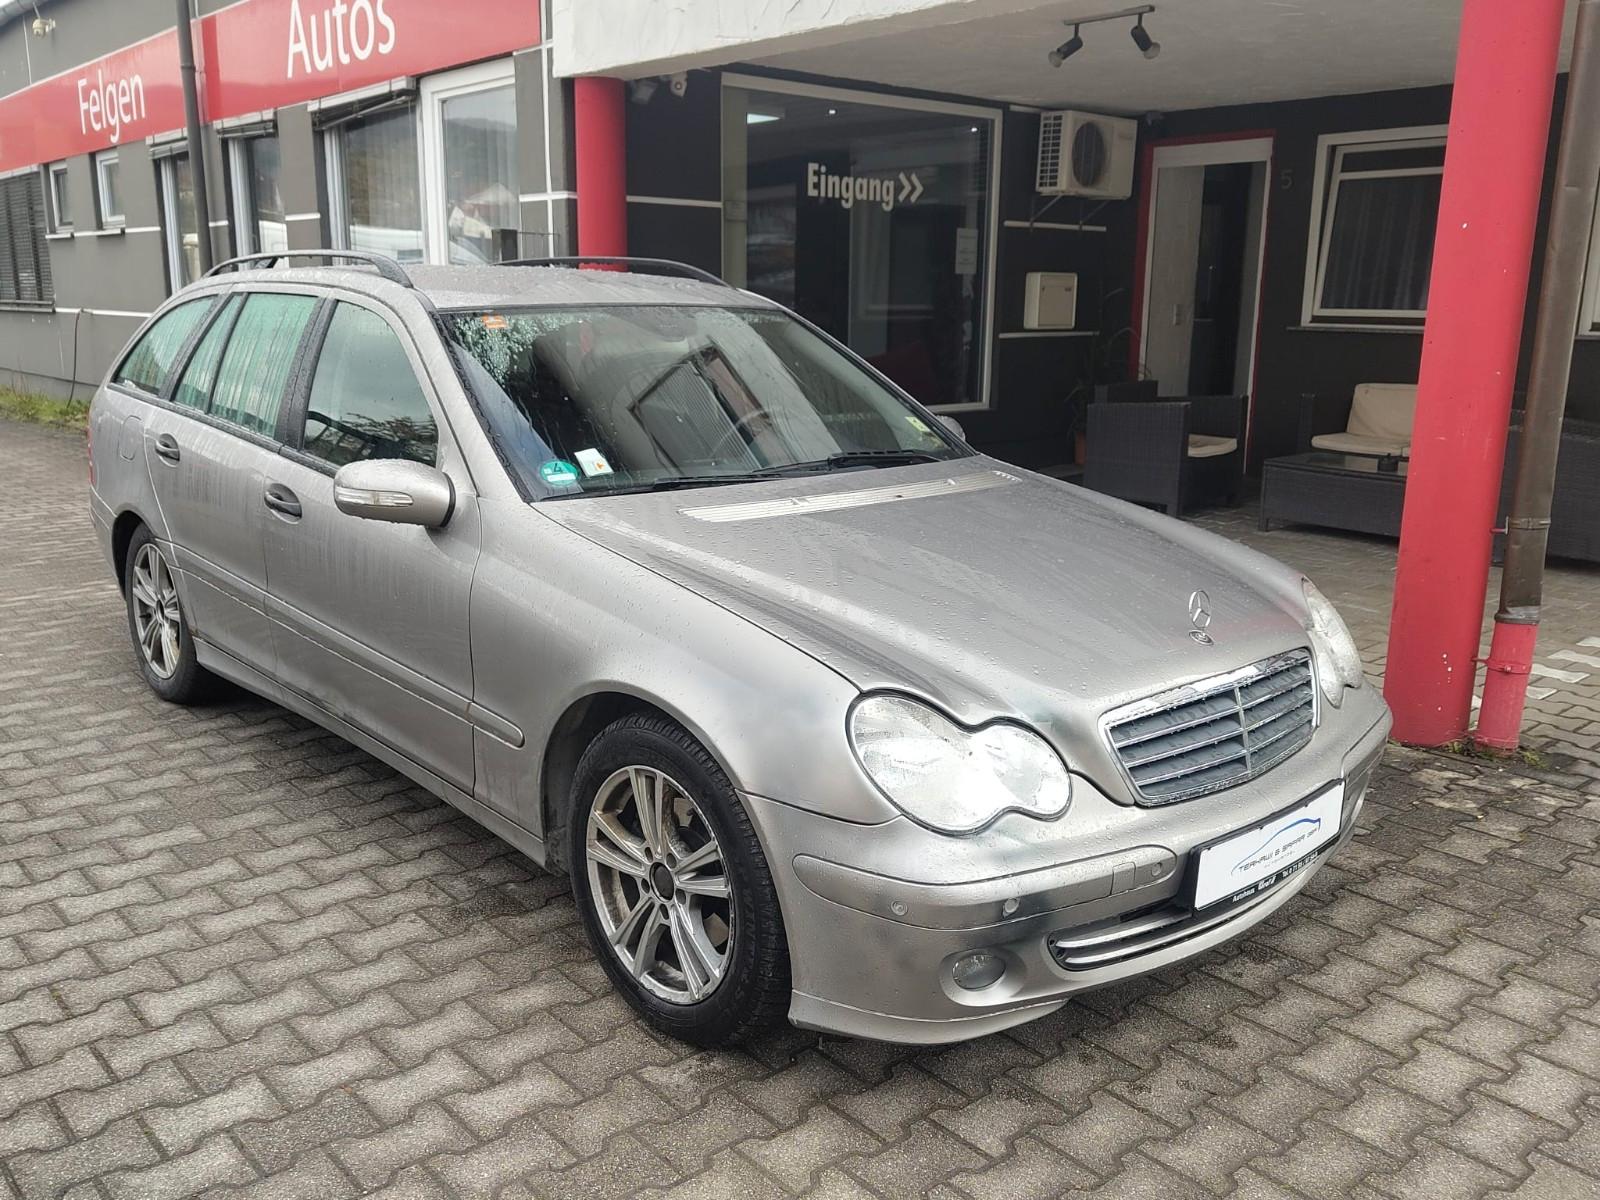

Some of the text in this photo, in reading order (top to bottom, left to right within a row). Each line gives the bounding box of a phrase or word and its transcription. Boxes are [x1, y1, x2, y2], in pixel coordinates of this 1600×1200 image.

[288, 0, 396, 78] Autos
[77, 68, 146, 144] Felgen
[807, 161, 895, 212] Eingang
[1280, 168, 1294, 190] 5
